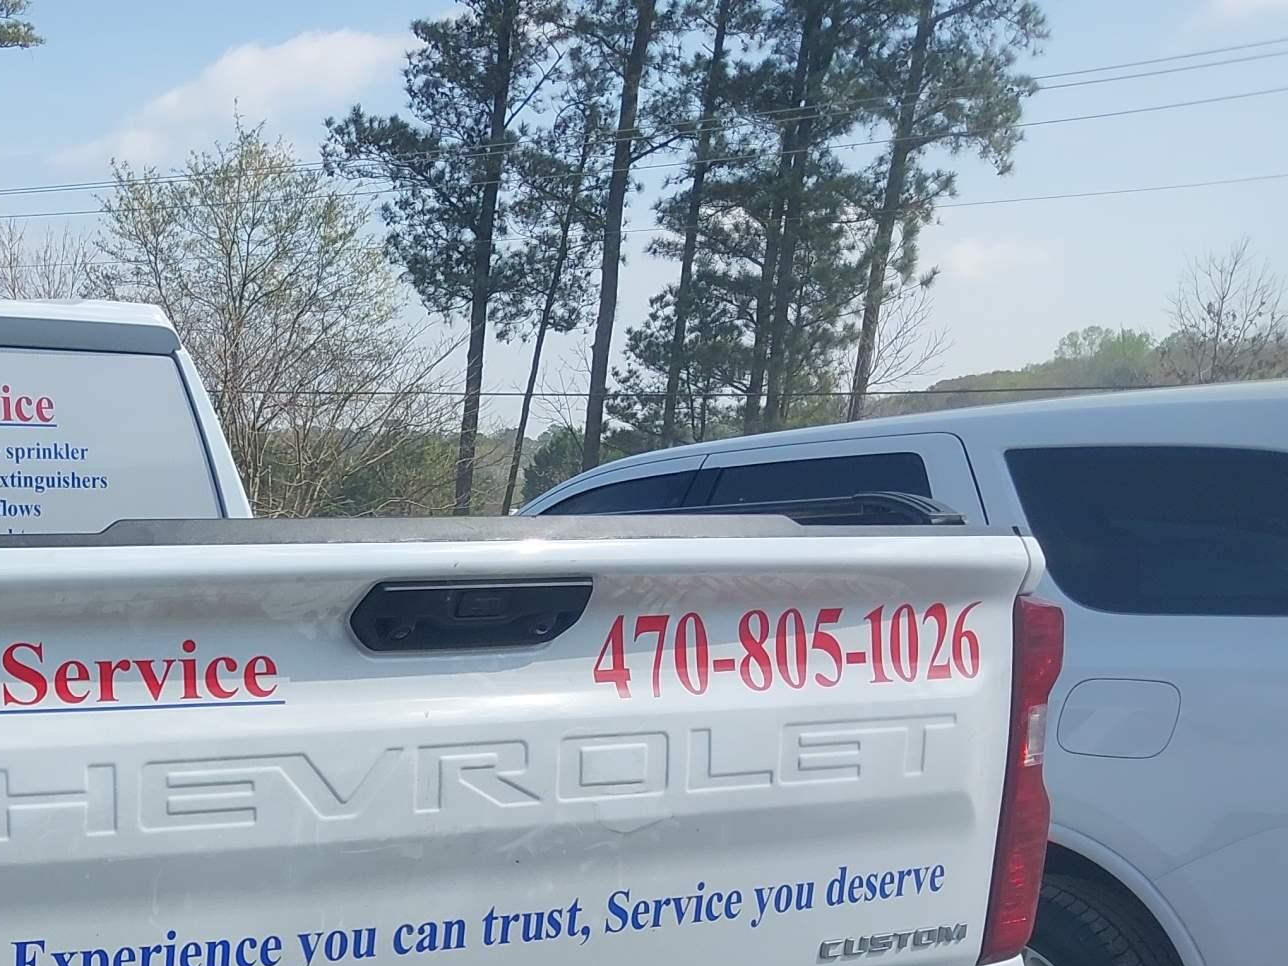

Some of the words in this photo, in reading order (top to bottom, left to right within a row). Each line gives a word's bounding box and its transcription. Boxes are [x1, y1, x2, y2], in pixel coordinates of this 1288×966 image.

[6, 442, 88, 463] sprinkler
[2, 639, 278, 706] Service
[592, 601, 983, 699] 470-805-1026
[393, 913, 466, 956] can
[482, 897, 590, 946] trust,
[604, 881, 742, 934] Service
[751, 880, 815, 927] you
[826, 864, 945, 906] deserve
[819, 922, 967, 960] CUSTOM
